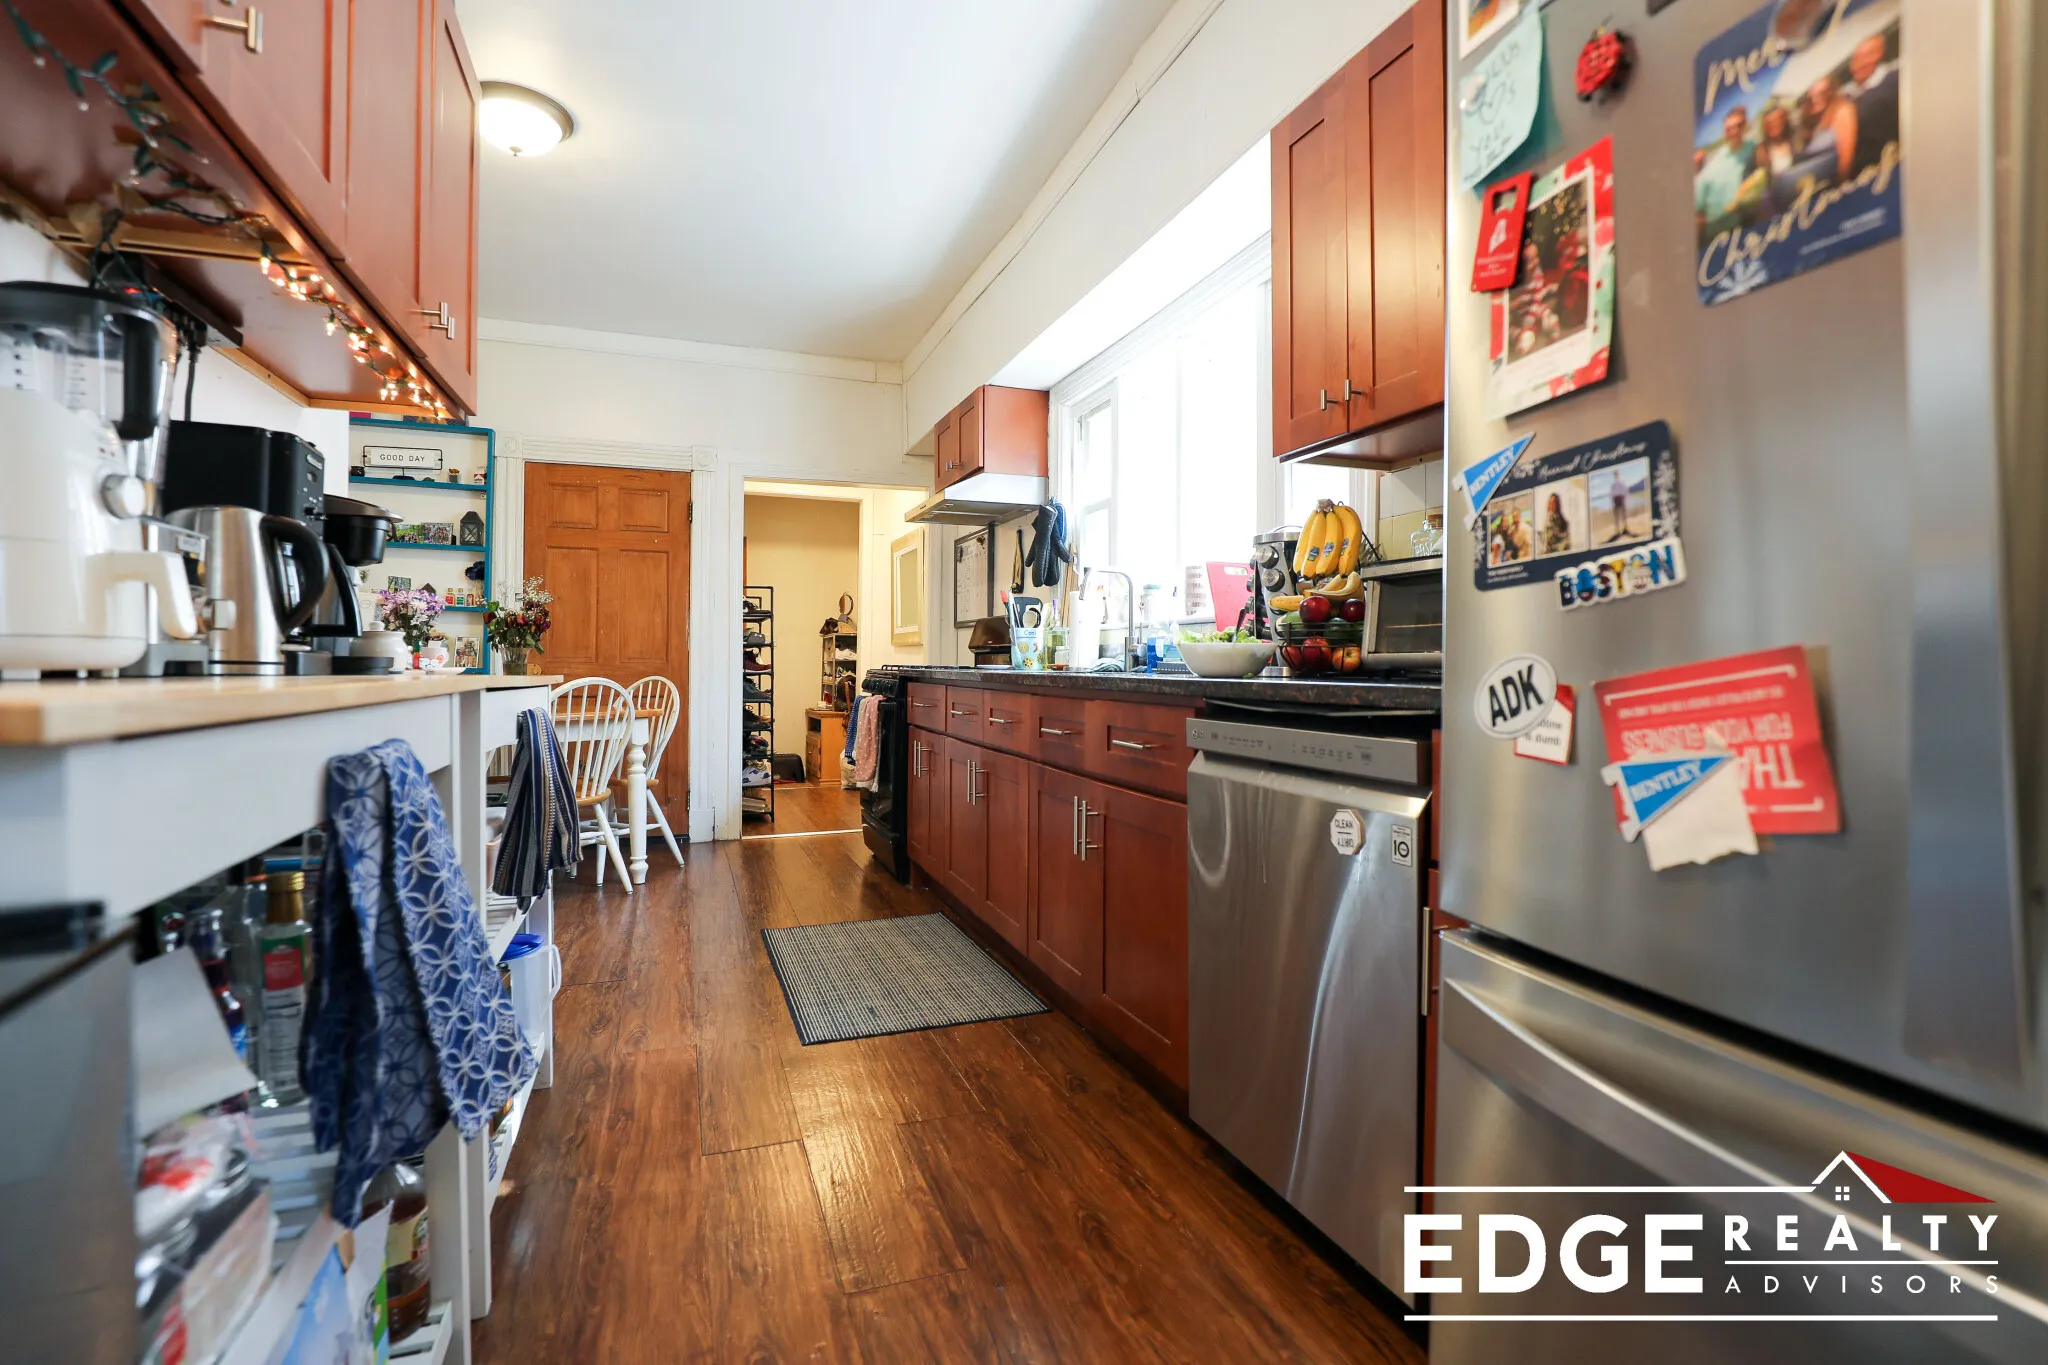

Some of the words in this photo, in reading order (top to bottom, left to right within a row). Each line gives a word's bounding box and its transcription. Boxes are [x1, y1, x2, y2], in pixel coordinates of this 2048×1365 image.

[380, 453, 404, 462] GOOD
[1469, 446, 1516, 497] BENTLEY
[1557, 544, 1678, 608] BOSTON
[1489, 663, 1544, 728] ADK
[1629, 760, 1702, 802] BENTLEY
[1334, 818, 1354, 829] CLEAN
[1393, 839, 1410, 858] 10
